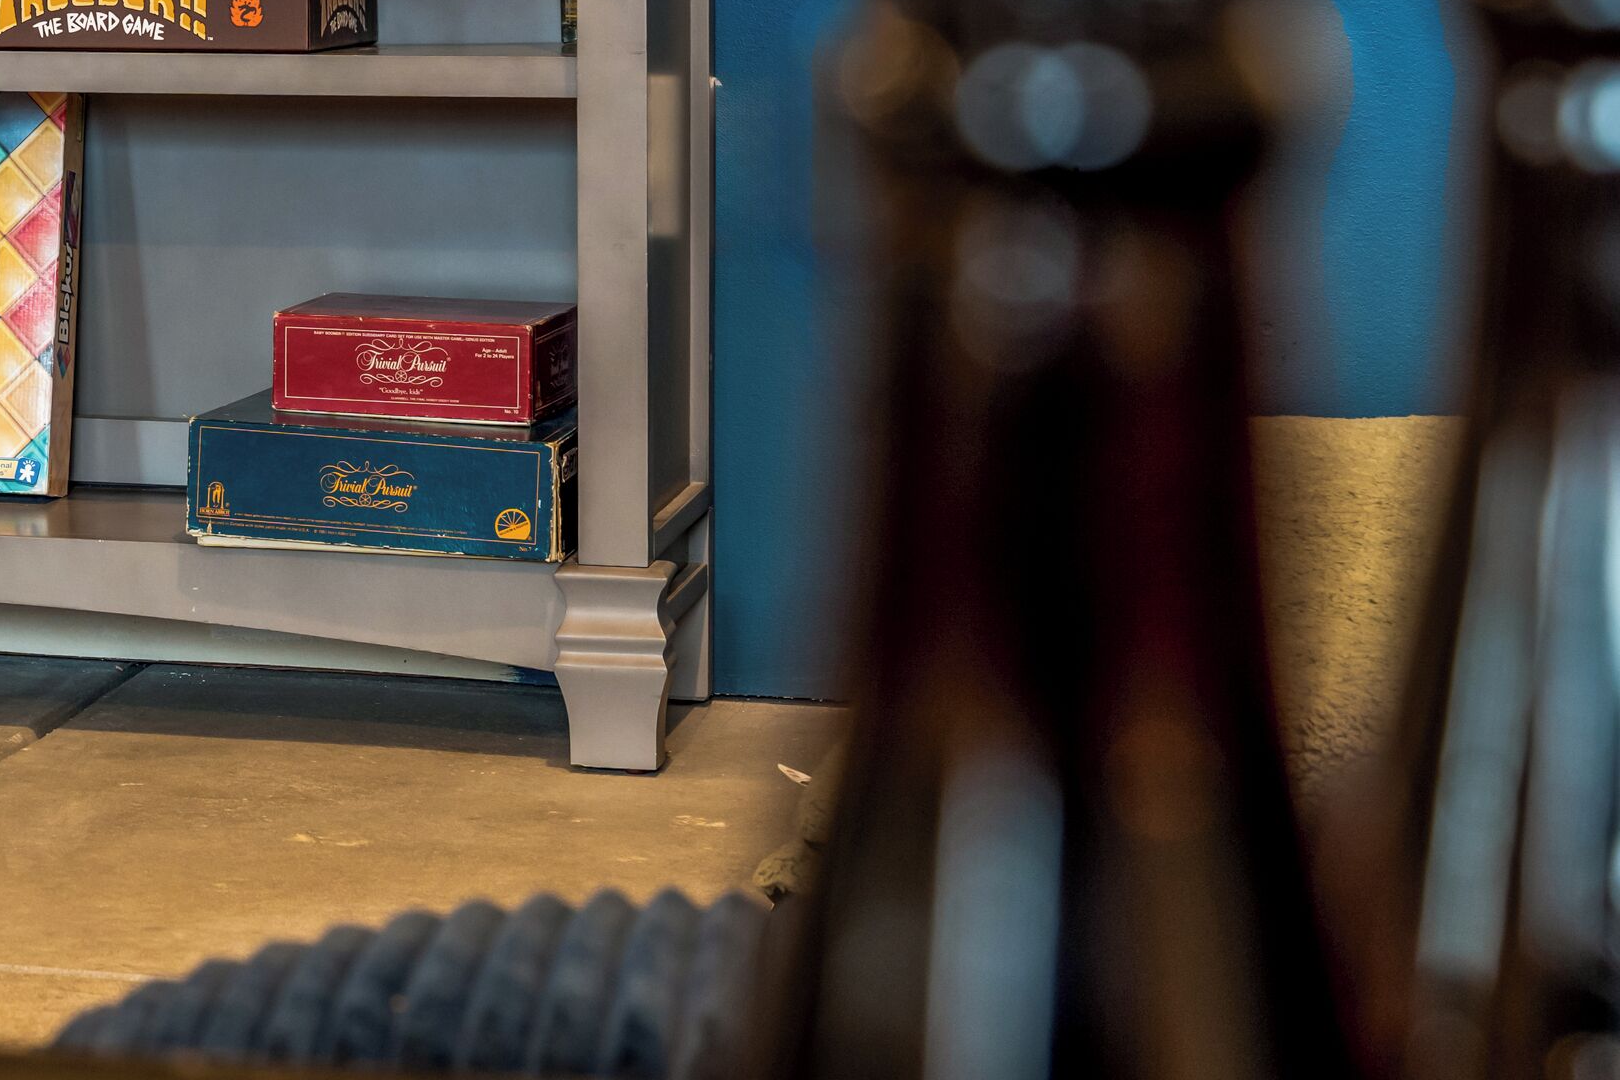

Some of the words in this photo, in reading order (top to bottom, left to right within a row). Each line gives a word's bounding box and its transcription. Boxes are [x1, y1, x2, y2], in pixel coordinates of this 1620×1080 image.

[33, 19, 63, 38] THE
[67, 11, 120, 32] BOARD
[122, 18, 165, 40] GAME
[58, 242, 74, 345] Blokus
[356, 350, 402, 372] Trivial
[401, 351, 446, 373] Pursuit
[320, 471, 368, 494] Trivial
[365, 474, 413, 497] Pursuit
